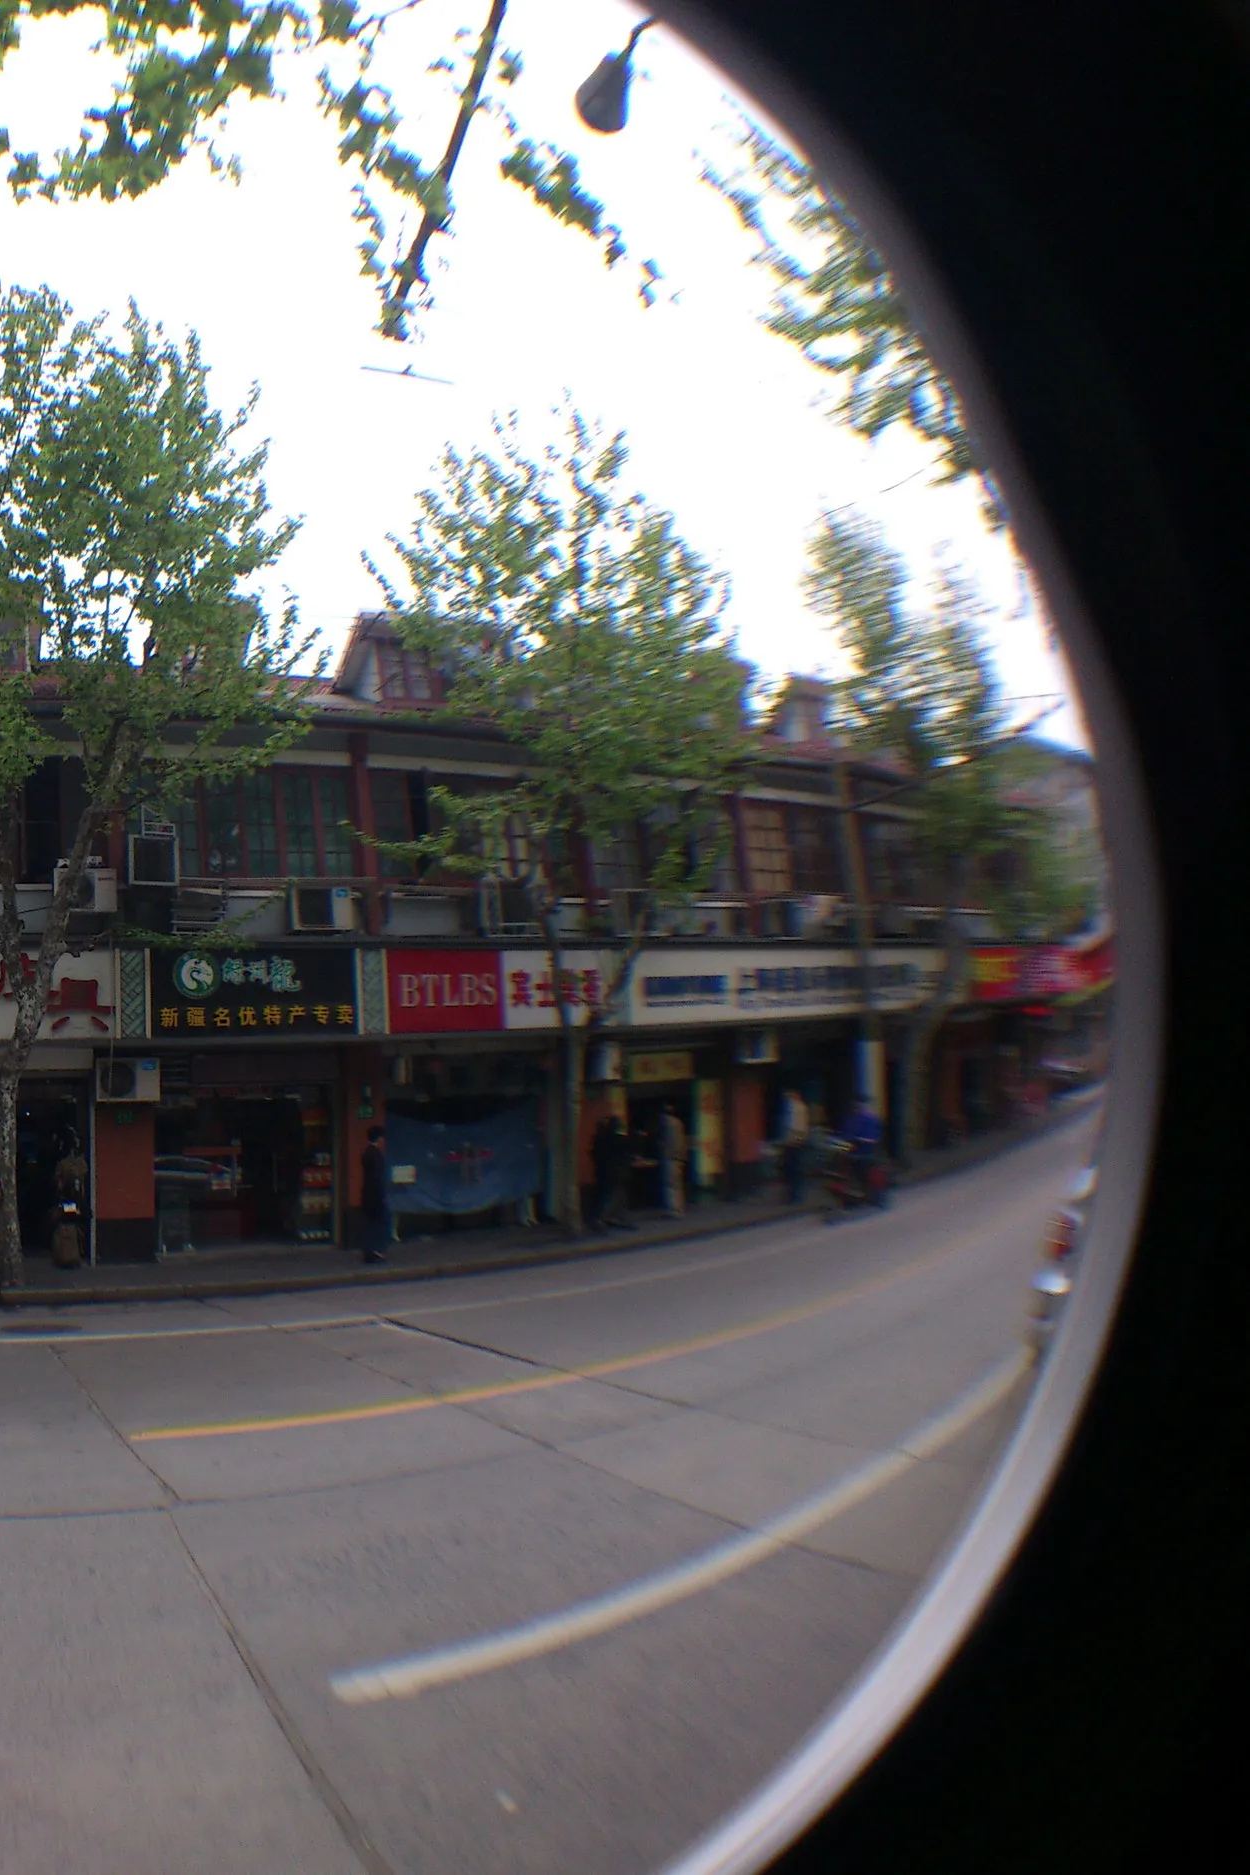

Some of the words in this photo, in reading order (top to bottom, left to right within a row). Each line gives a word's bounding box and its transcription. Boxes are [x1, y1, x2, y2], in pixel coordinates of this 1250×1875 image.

[398, 973, 498, 1007] BTLBS
[158, 1004, 354, 1028] 新疆名优特产专卖
